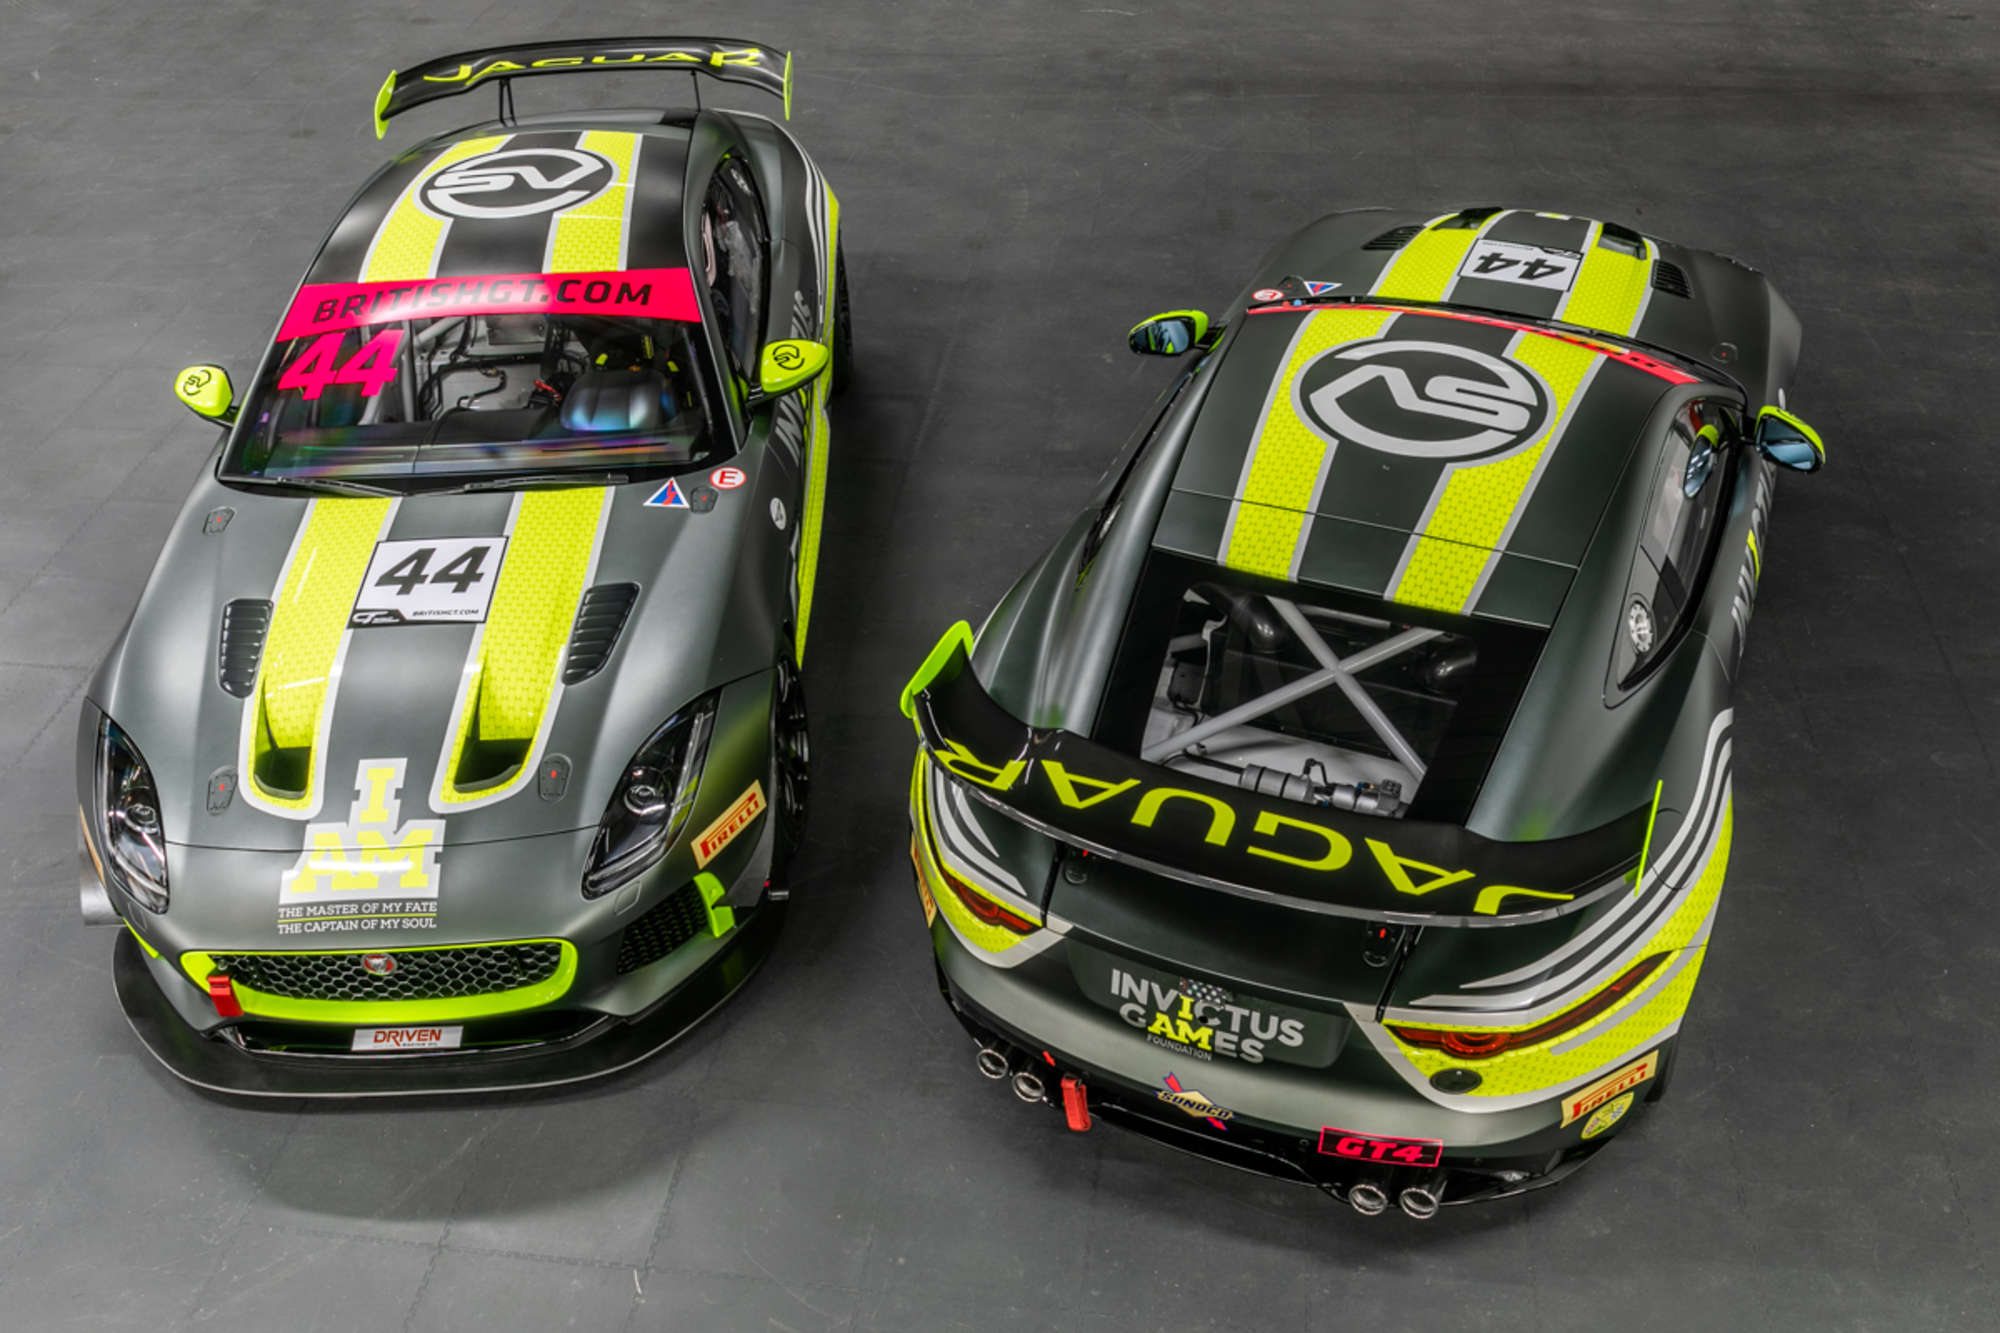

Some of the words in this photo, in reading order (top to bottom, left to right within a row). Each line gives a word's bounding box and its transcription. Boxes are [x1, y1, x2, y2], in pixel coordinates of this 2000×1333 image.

[424, 48, 761, 86] JAGUAR
[1473, 252, 1567, 280] 44
[312, 279, 652, 324] BRITISHGT.COM
[277, 329, 405, 401] 44
[374, 545, 492, 596] 44
[359, 767, 396, 823] I
[700, 792, 760, 859] PIRELLI
[933, 738, 1575, 916] JAGUAR
[290, 829, 435, 893] AM
[277, 923, 302, 935] THE
[304, 920, 359, 933] CAPTAIN
[360, 918, 378, 930] OF
[380, 918, 400, 929] MY
[402, 917, 437, 929] SOUL
[278, 907, 303, 919] THE
[306, 904, 359, 917] MASTER
[361, 903, 380, 914] OF
[382, 902, 402, 914] MY
[405, 901, 438, 913] FATE
[1111, 968, 1304, 1047] INVICTUS
[373, 1029, 442, 1047] DRIVEN
[1119, 1003, 1264, 1064] GAMES
[1147, 1034, 1213, 1062] FOUNDATION
[1159, 1090, 1231, 1121] SUNOCO
[1571, 1063, 1648, 1119] PIRELLI
[1336, 1136, 1424, 1162] GT4
